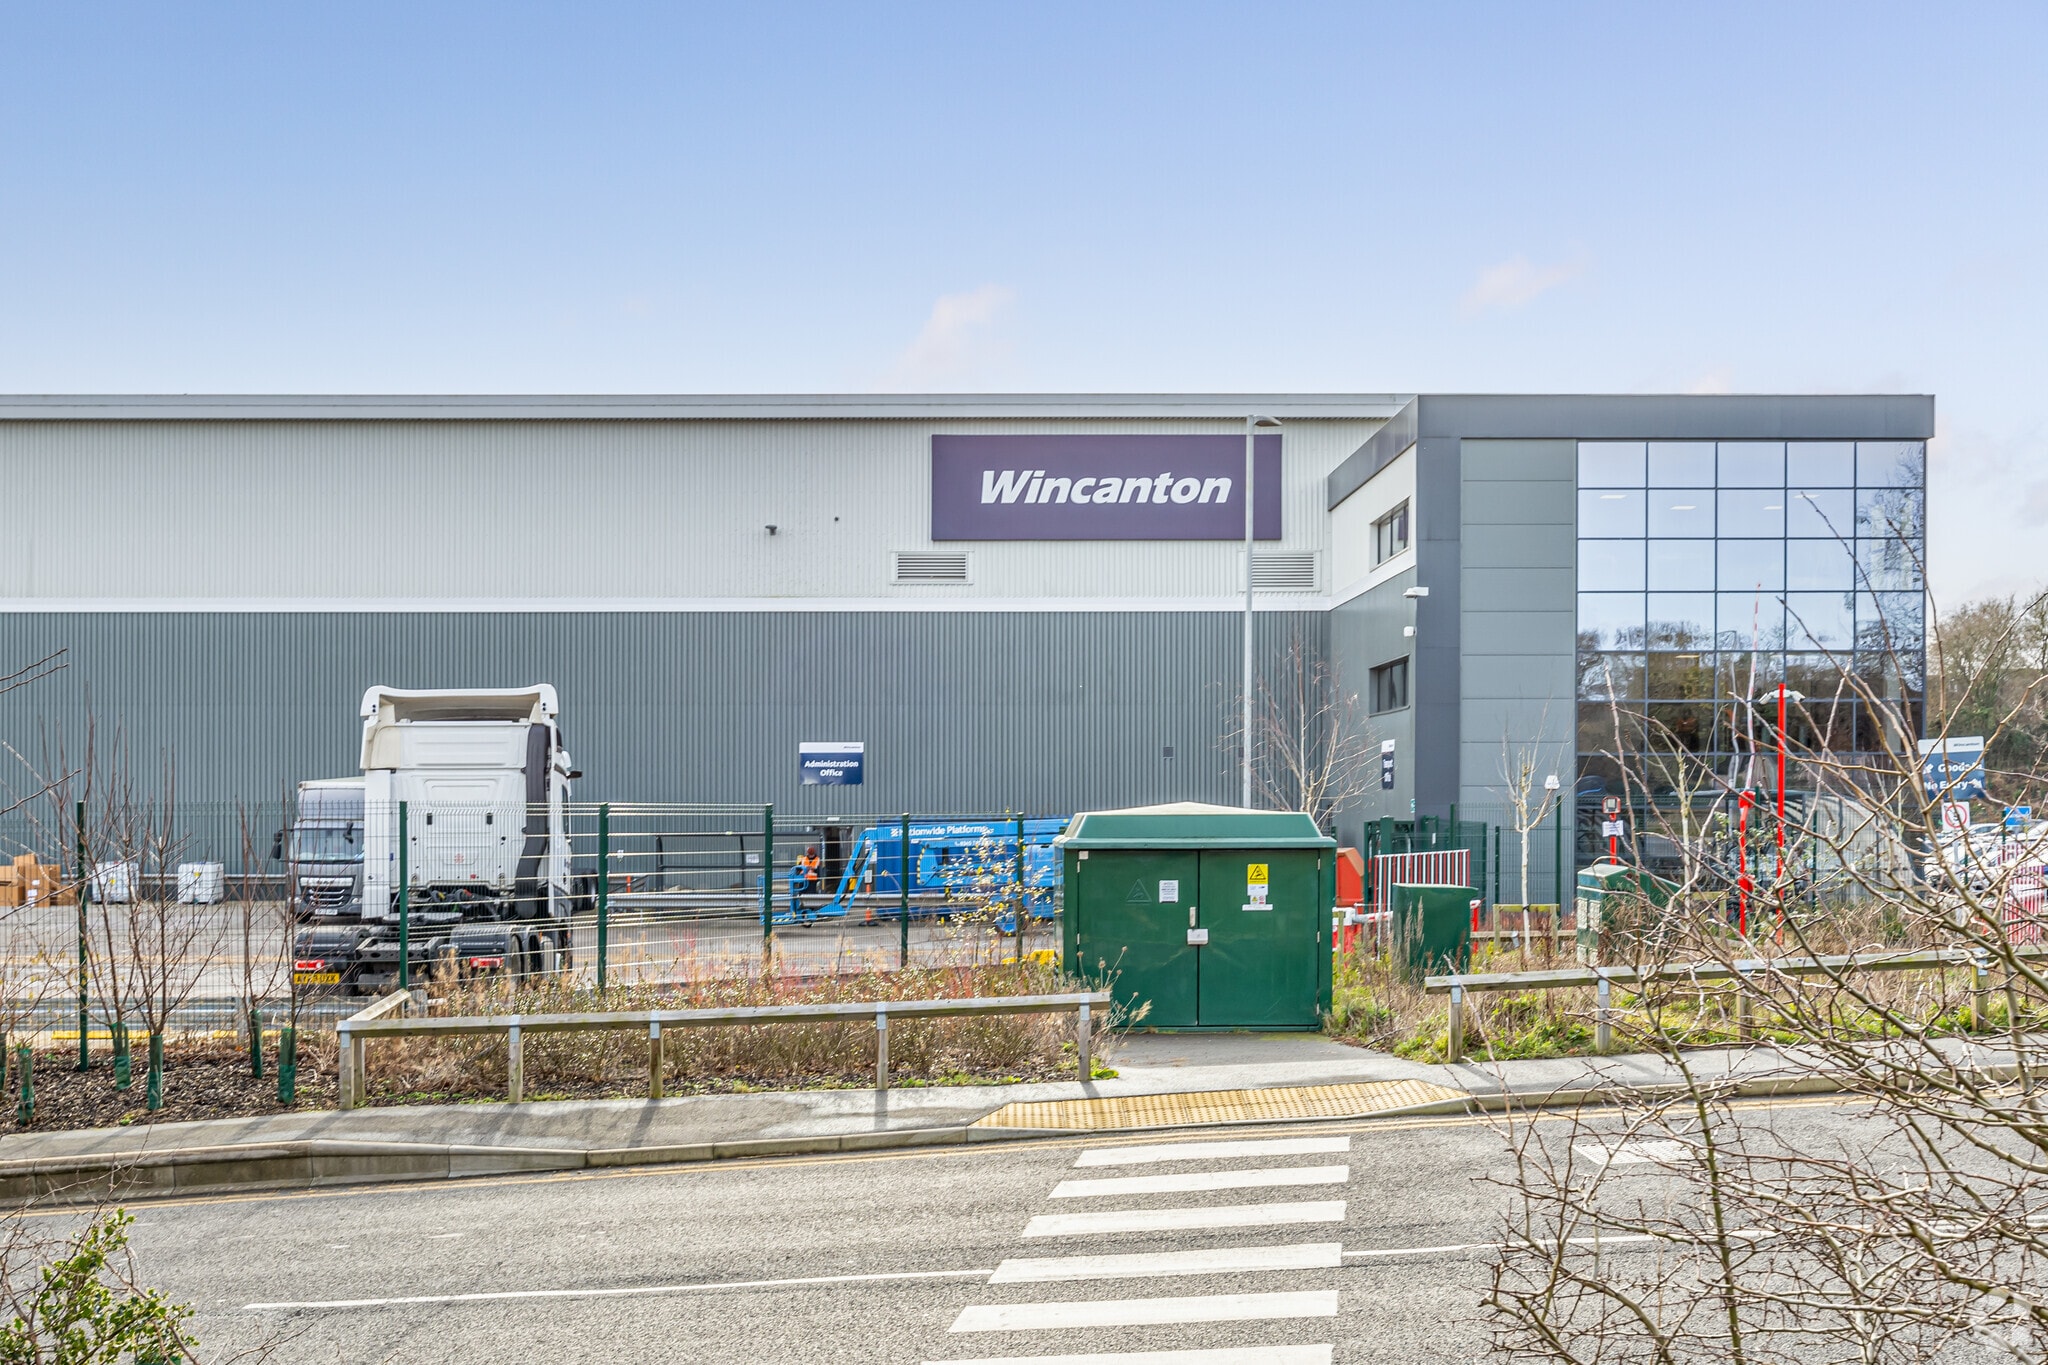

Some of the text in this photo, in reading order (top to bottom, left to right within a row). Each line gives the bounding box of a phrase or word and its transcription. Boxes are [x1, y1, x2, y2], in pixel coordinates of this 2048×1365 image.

[980, 470, 1232, 504] Wincanton
[804, 760, 859, 768] Administration
[819, 768, 844, 777] Office
[899, 826, 945, 836] tionwide
